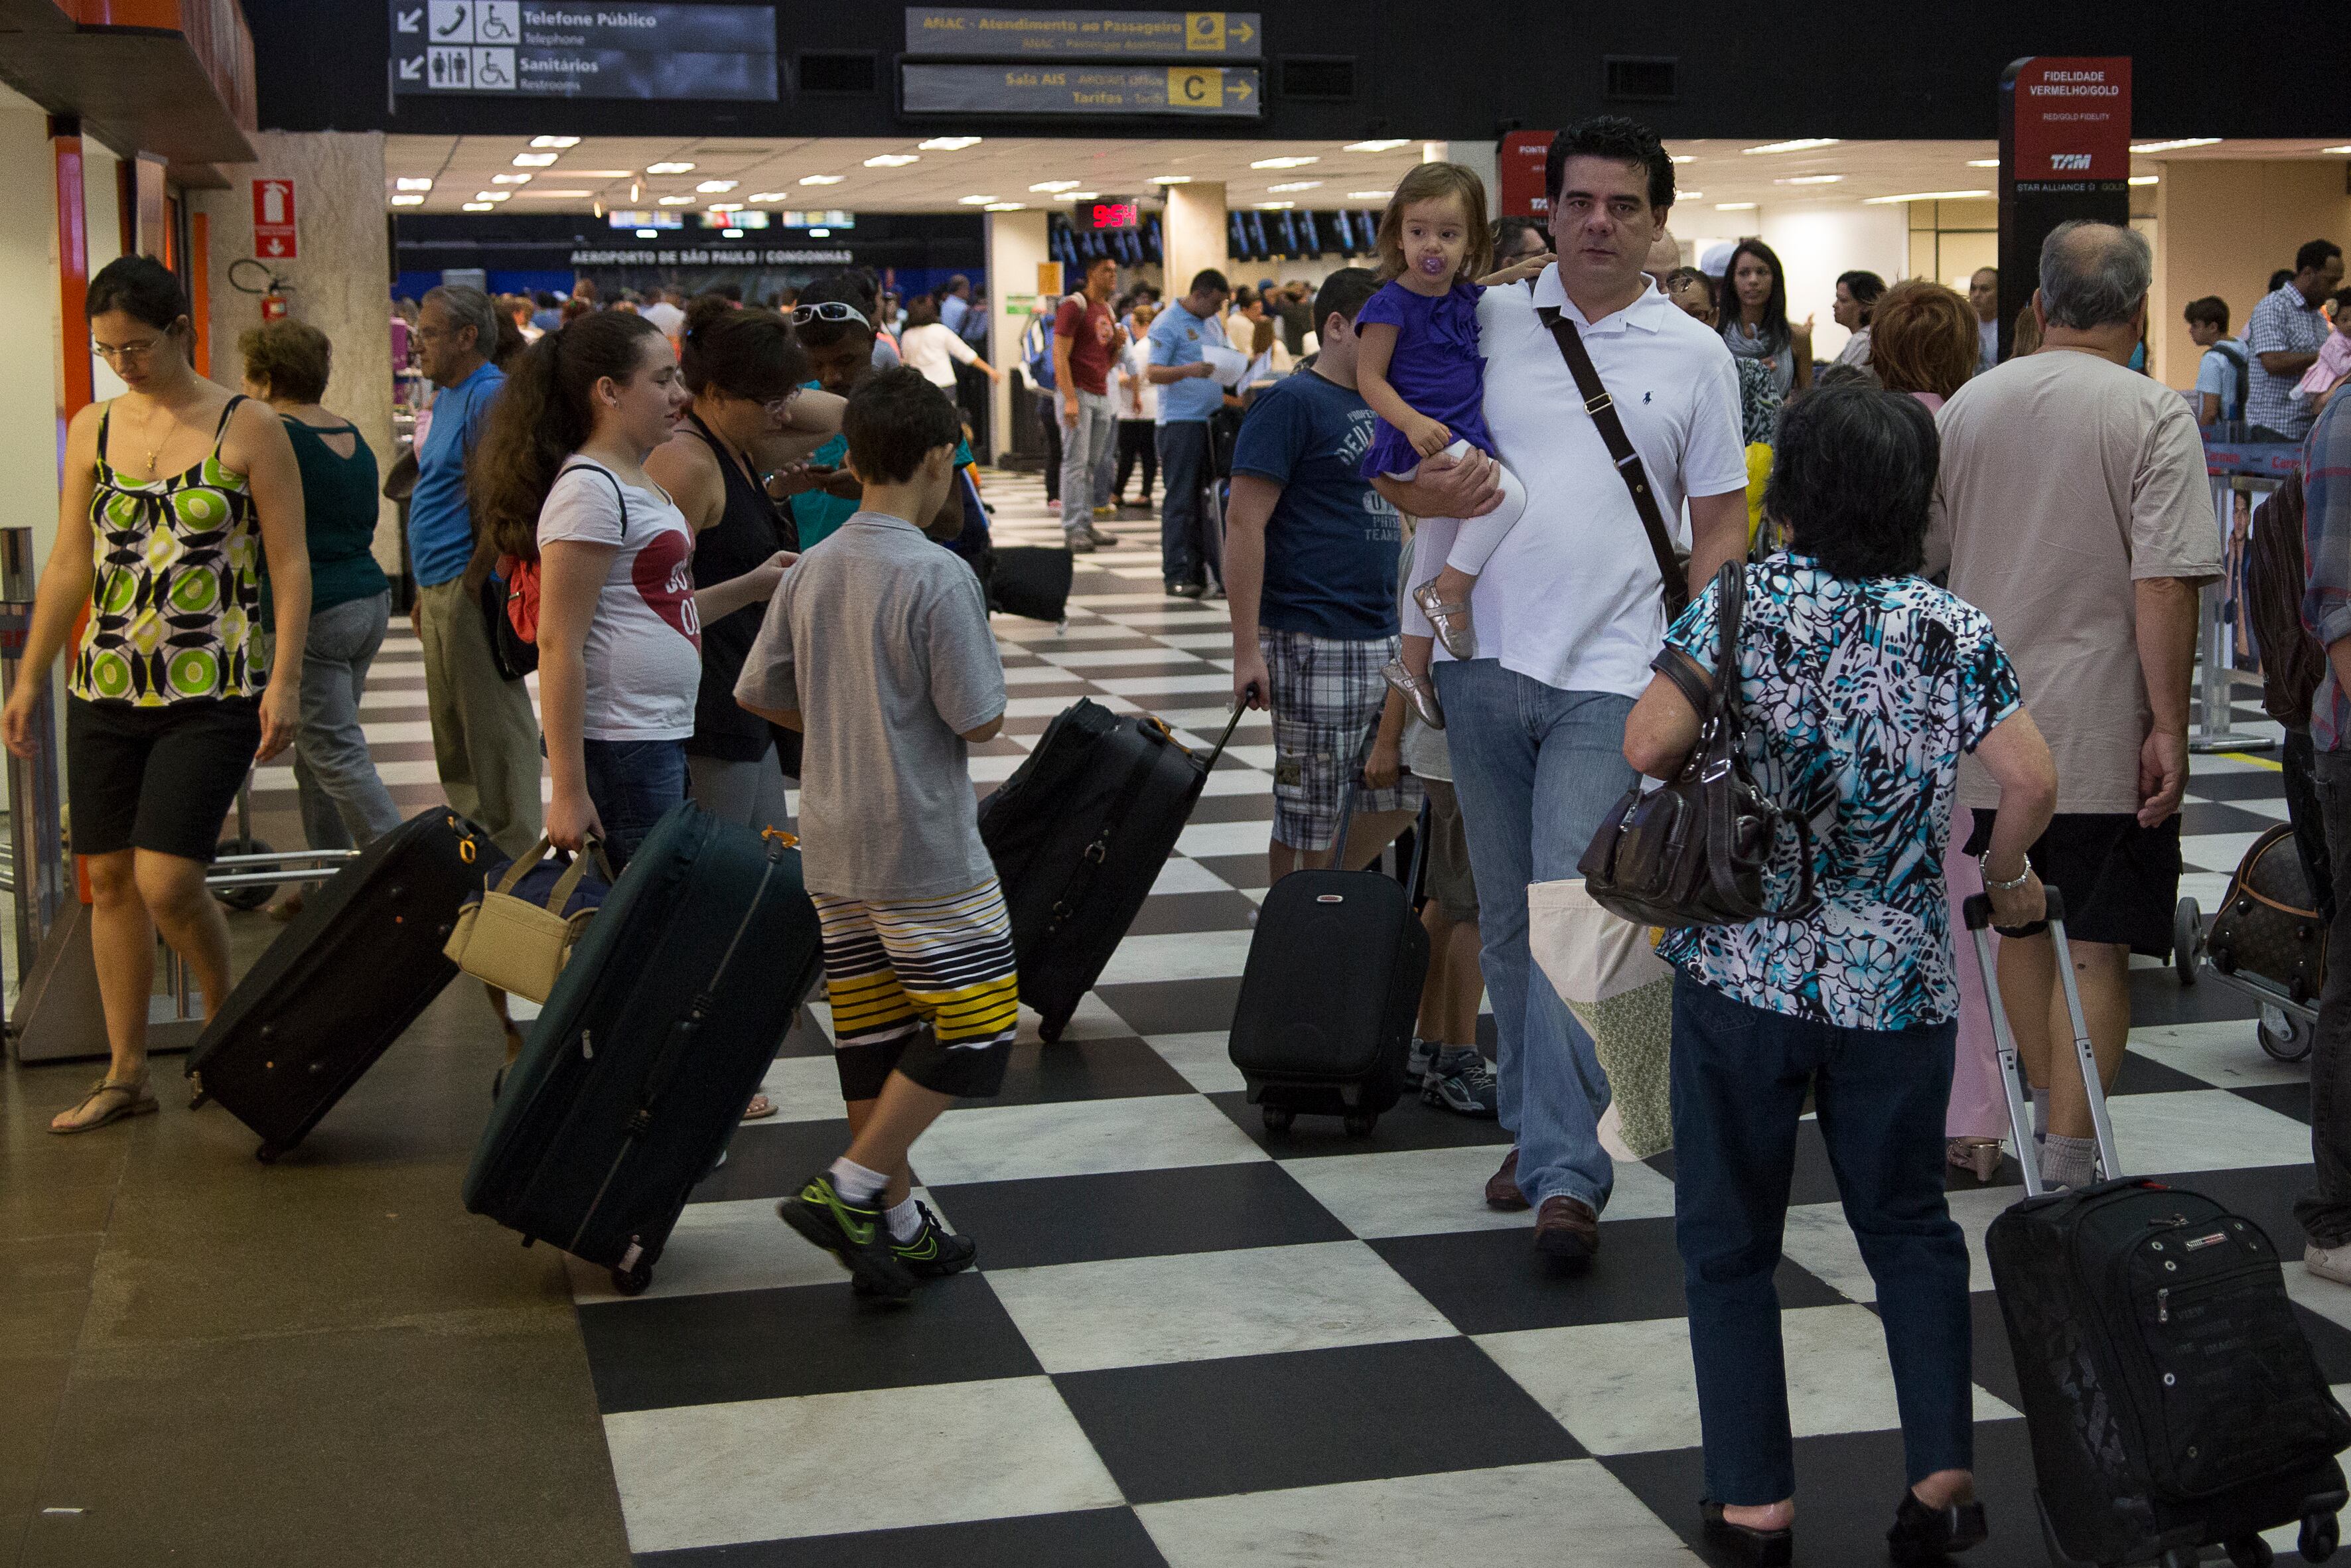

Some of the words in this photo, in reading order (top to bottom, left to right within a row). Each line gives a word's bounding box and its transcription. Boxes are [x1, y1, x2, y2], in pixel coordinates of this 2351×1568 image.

[524, 11, 594, 26] Telefone
[597, 11, 657, 28] Público
[924, 17, 965, 29] ANAC
[979, 18, 1078, 31] Atendimento
[1104, 21, 1182, 35] Passageiro
[526, 33, 586, 46] Telephone
[521, 58, 599, 72] Sanitários
[1006, 72, 1038, 86] Sala
[1041, 74, 1066, 86] AIS
[2044, 71, 2105, 82] FIDELIDADE
[1184, 74, 1206, 100] C
[2030, 85, 2120, 97] VERMELHO/GOLD
[1072, 91, 1123, 105] Tarifas
[2050, 153, 2092, 171] TAM
[2017, 183, 2040, 192] STAR
[2042, 183, 2086, 192] ALLIANCE
[1093, 204, 1137, 228] 9:54
[571, 249, 656, 264] AEROPORTO
[658, 249, 677, 264] DE
[679, 248, 709, 264] SÃO
[711, 249, 756, 264] PAULO
[766, 249, 853, 264] CONGONHAS
